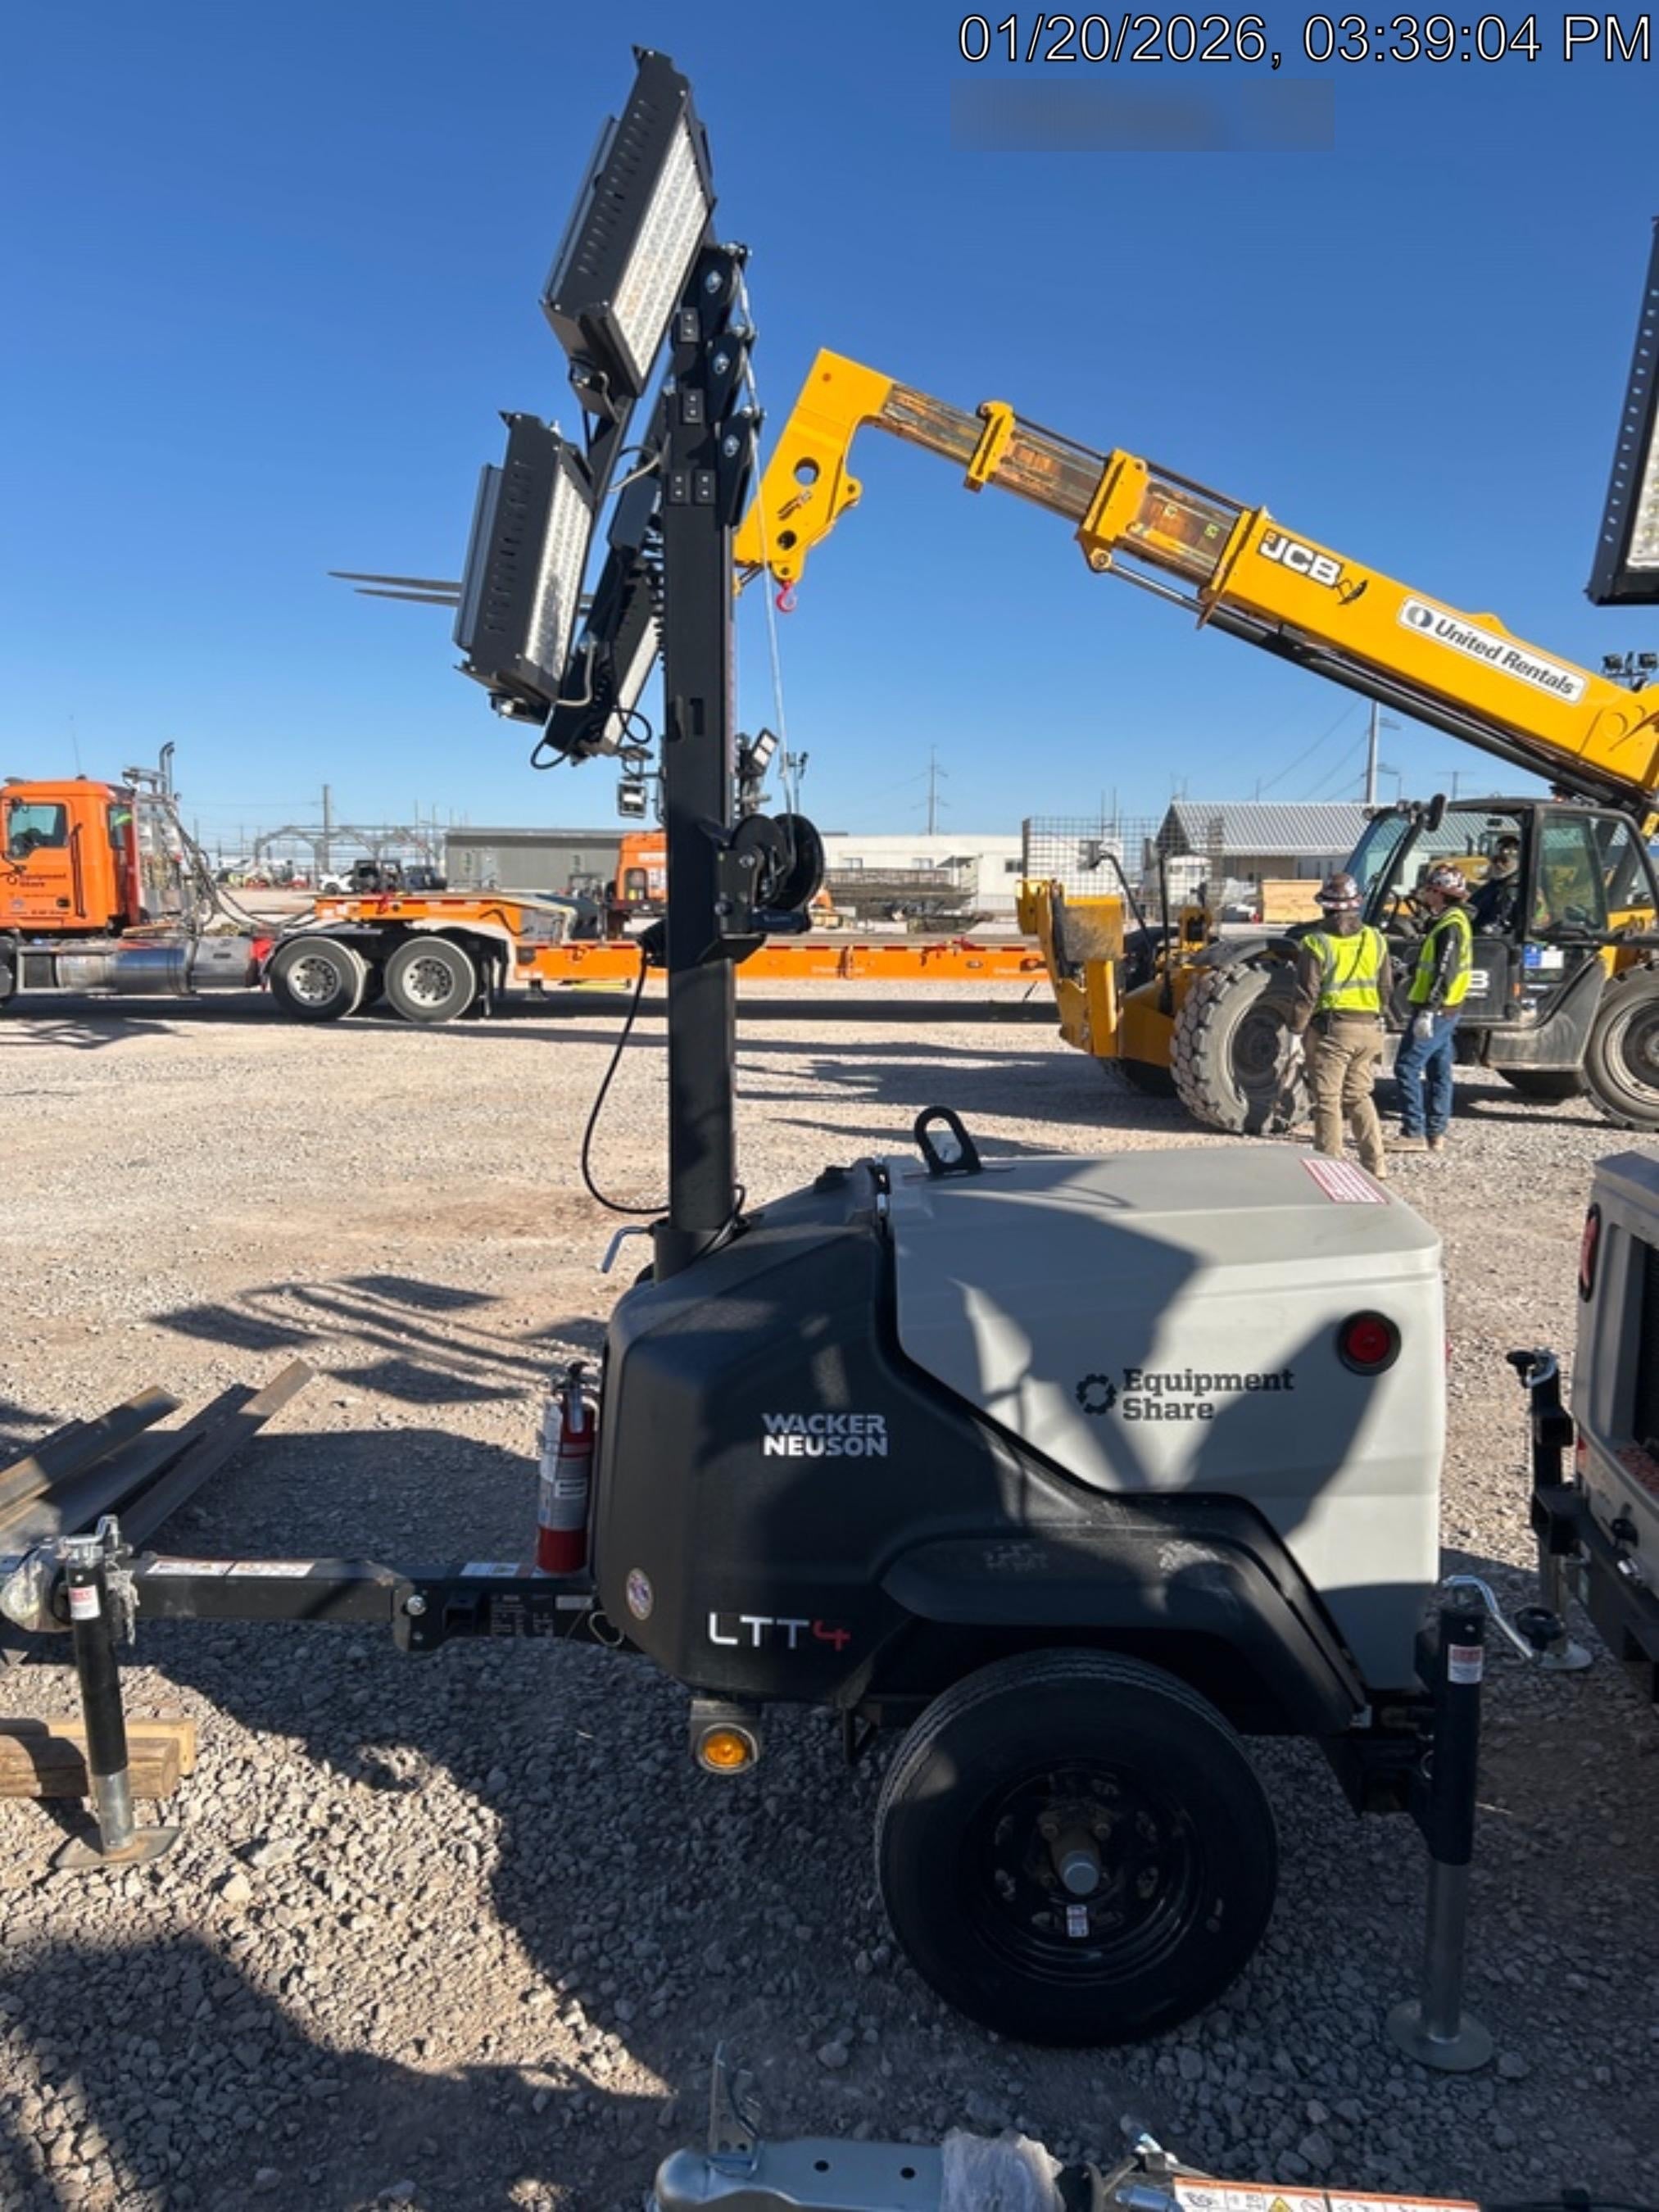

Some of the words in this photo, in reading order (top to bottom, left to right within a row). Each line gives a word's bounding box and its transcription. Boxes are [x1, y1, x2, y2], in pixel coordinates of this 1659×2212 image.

[1260, 534, 1341, 586] JCB
[1435, 619, 1503, 660] United
[1502, 650, 1575, 695] Rentals
[1123, 1368, 1294, 1396] Equipment
[762, 1413, 886, 1434] WACKER
[1123, 1398, 1214, 1421] Share
[764, 1435, 888, 1456] NEUSON
[709, 1611, 851, 1651] LTT4
